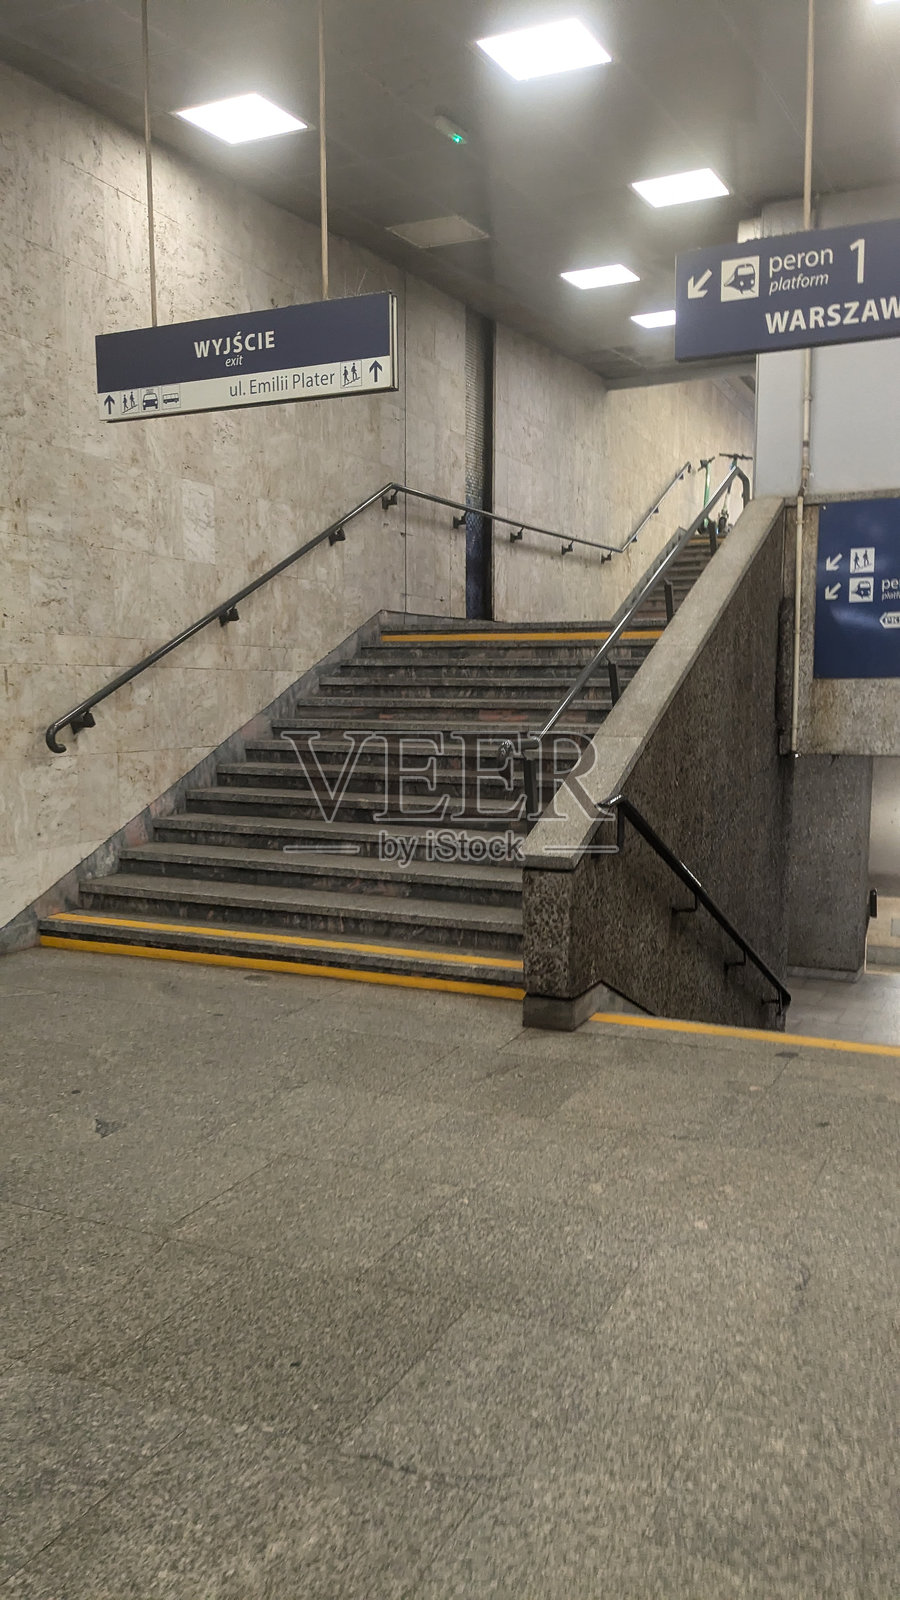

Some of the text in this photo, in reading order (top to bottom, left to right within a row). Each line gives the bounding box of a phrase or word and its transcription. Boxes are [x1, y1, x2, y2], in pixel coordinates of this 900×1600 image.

[769, 238, 866, 285] peron 1
[769, 273, 829, 296] platform
[194, 331, 275, 358] WYJŚCIE
[225, 355, 243, 367] exit
[229, 372, 335, 397] ul. Emilii Plater
[882, 578, 900, 593] pe
